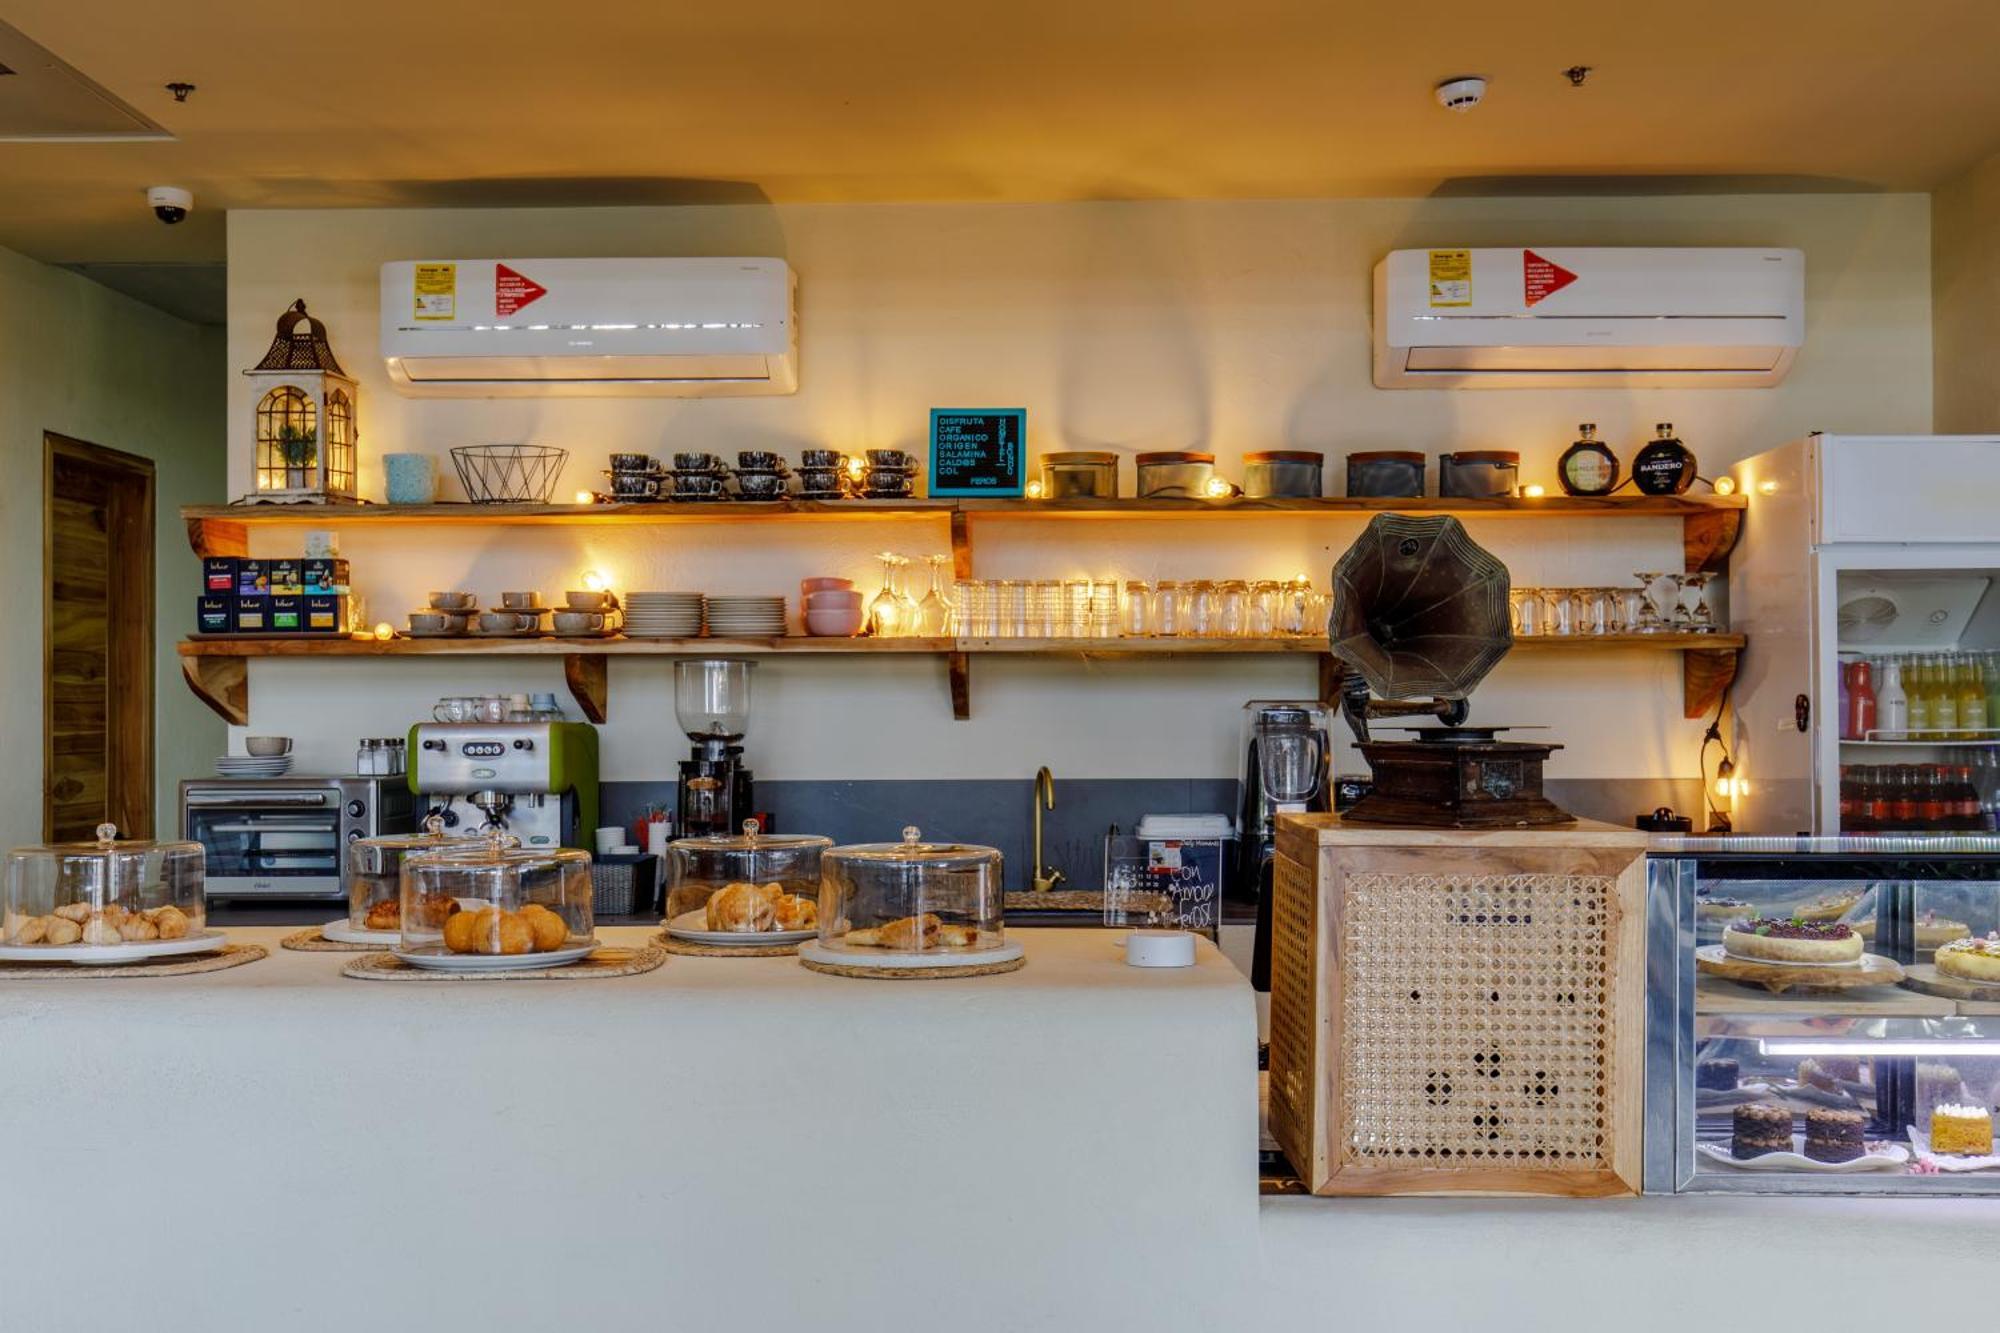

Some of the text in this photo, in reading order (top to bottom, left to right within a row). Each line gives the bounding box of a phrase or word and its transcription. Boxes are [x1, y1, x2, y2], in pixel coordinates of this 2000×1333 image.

[939, 417, 984, 425] DISFRUTA
[939, 426, 962, 434] CAFE
[939, 434, 989, 442] ORGANICO
[938, 442, 978, 450] ORIGEN
[939, 450, 987, 458] SALAMINA
[939, 467, 959, 475] COL
[1640, 462, 1683, 472] BANDERO
